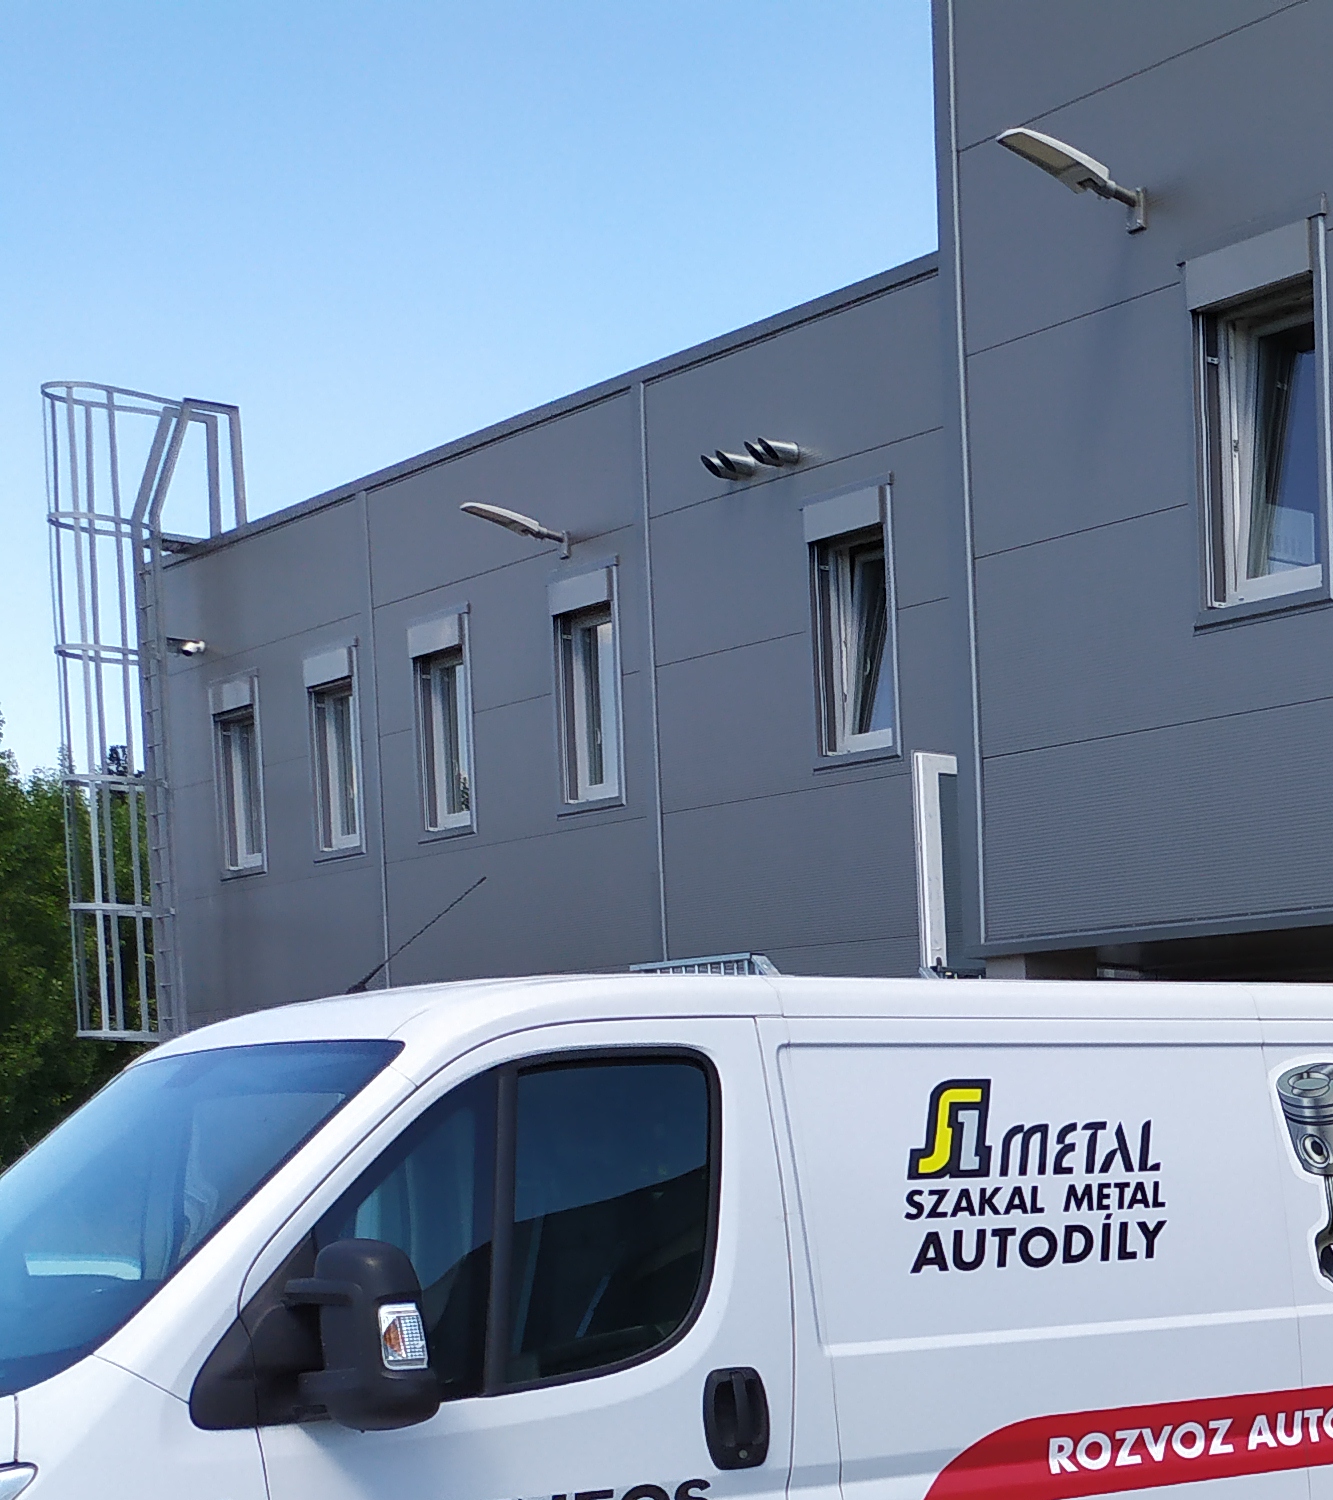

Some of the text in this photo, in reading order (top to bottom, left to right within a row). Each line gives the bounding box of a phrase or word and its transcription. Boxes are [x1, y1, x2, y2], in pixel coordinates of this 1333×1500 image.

[999, 1119, 1162, 1178] METAL
[904, 1181, 1167, 1221] SZAKAL METAL
[910, 1213, 1168, 1274] AUTODÍLY
[1048, 1418, 1234, 1474] ROZVOZ
